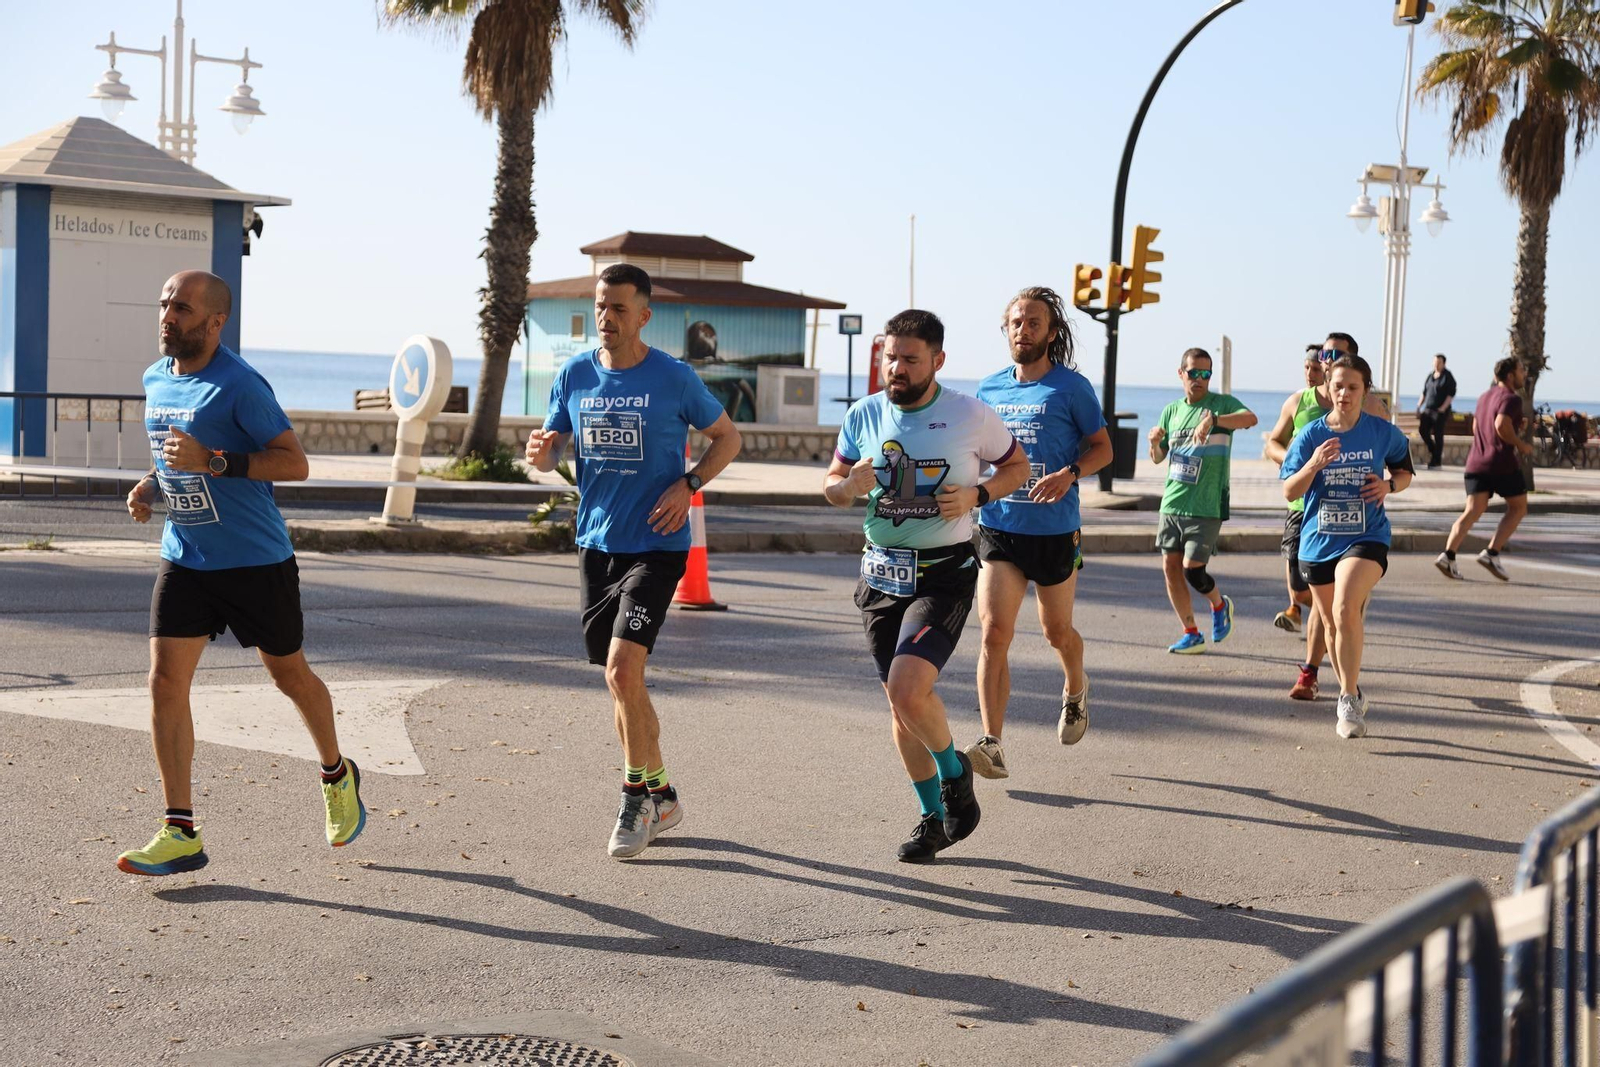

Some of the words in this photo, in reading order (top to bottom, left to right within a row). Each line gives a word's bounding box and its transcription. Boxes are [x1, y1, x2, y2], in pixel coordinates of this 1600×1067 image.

[54, 214, 114, 234] Helados
[118, 219, 125, 235] /
[129, 220, 150, 237] Ice
[154, 222, 208, 242] Creams
[579, 393, 650, 411] mayoral
[995, 403, 1047, 415] mayoral
[587, 429, 634, 444] 1520
[1334, 449, 1374, 463] yoral
[1323, 512, 1359, 522] 2124
[867, 561, 909, 581] 1910
[634, 605, 648, 614] NEW
[625, 610, 652, 625] BALANCE
